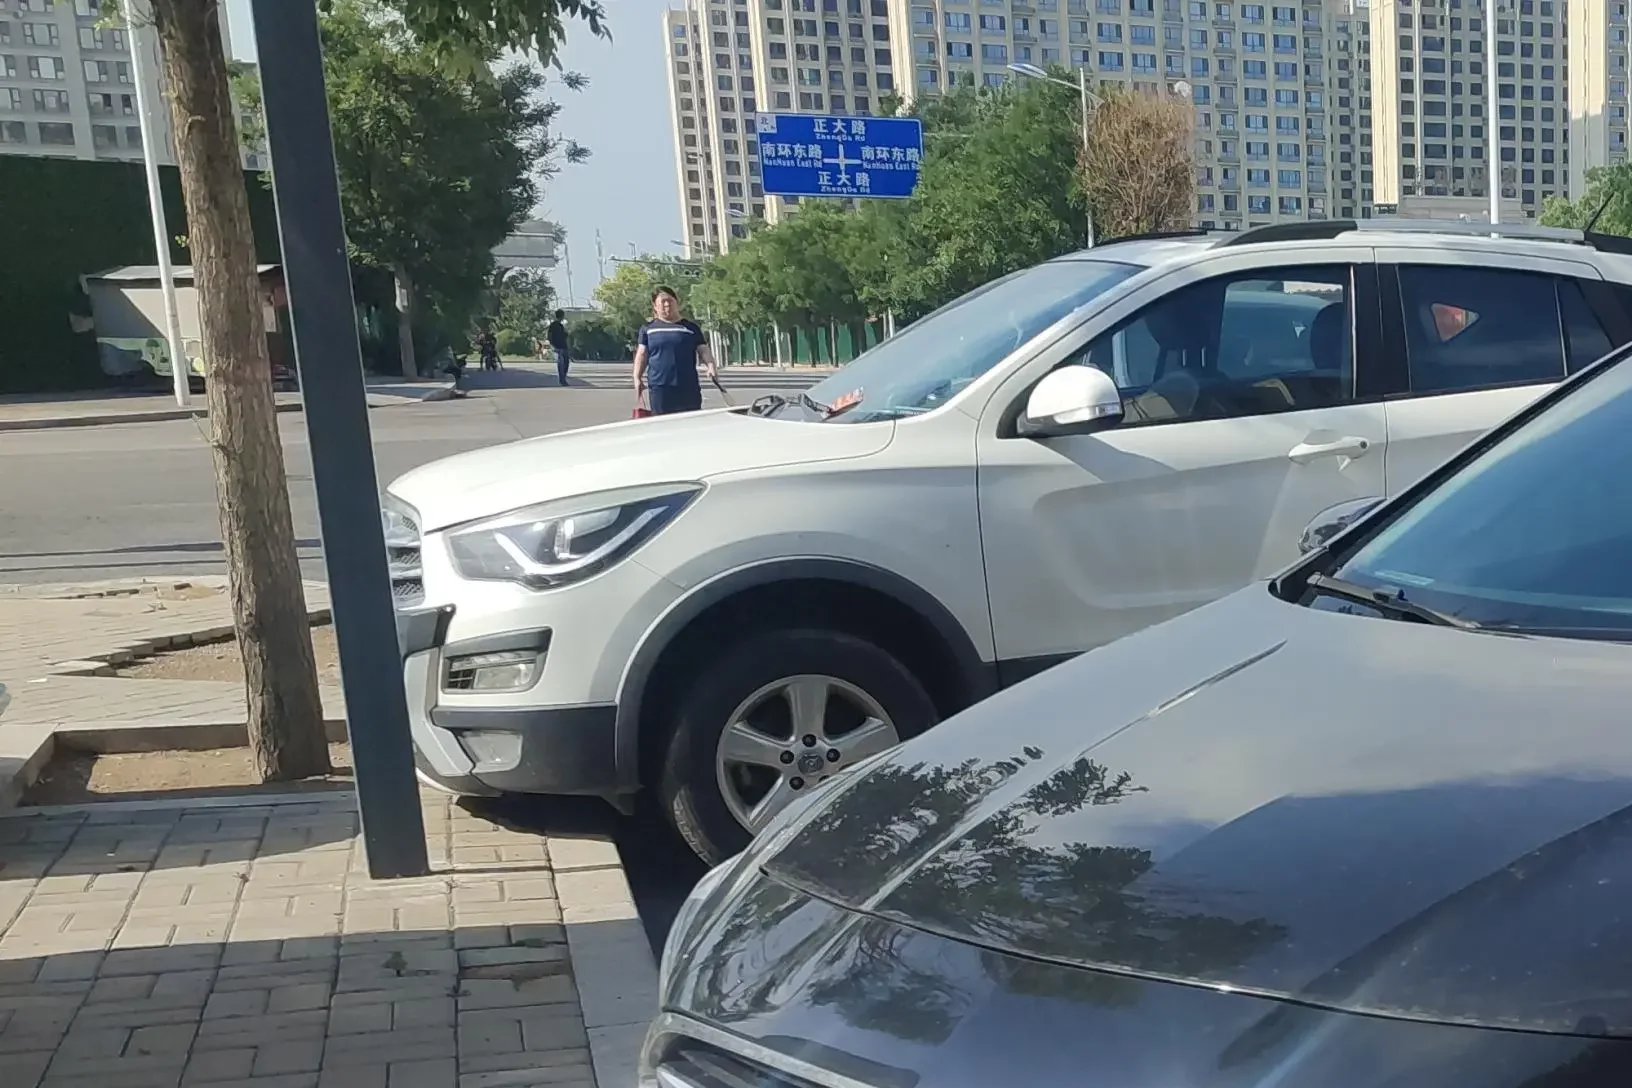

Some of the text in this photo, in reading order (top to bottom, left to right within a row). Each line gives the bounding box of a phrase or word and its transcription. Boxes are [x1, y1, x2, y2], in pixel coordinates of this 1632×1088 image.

[813, 118, 866, 135] 正大路
[762, 141, 822, 159] 南环东路
[860, 145, 920, 162] 南环东路
[817, 170, 870, 187] 正大路
